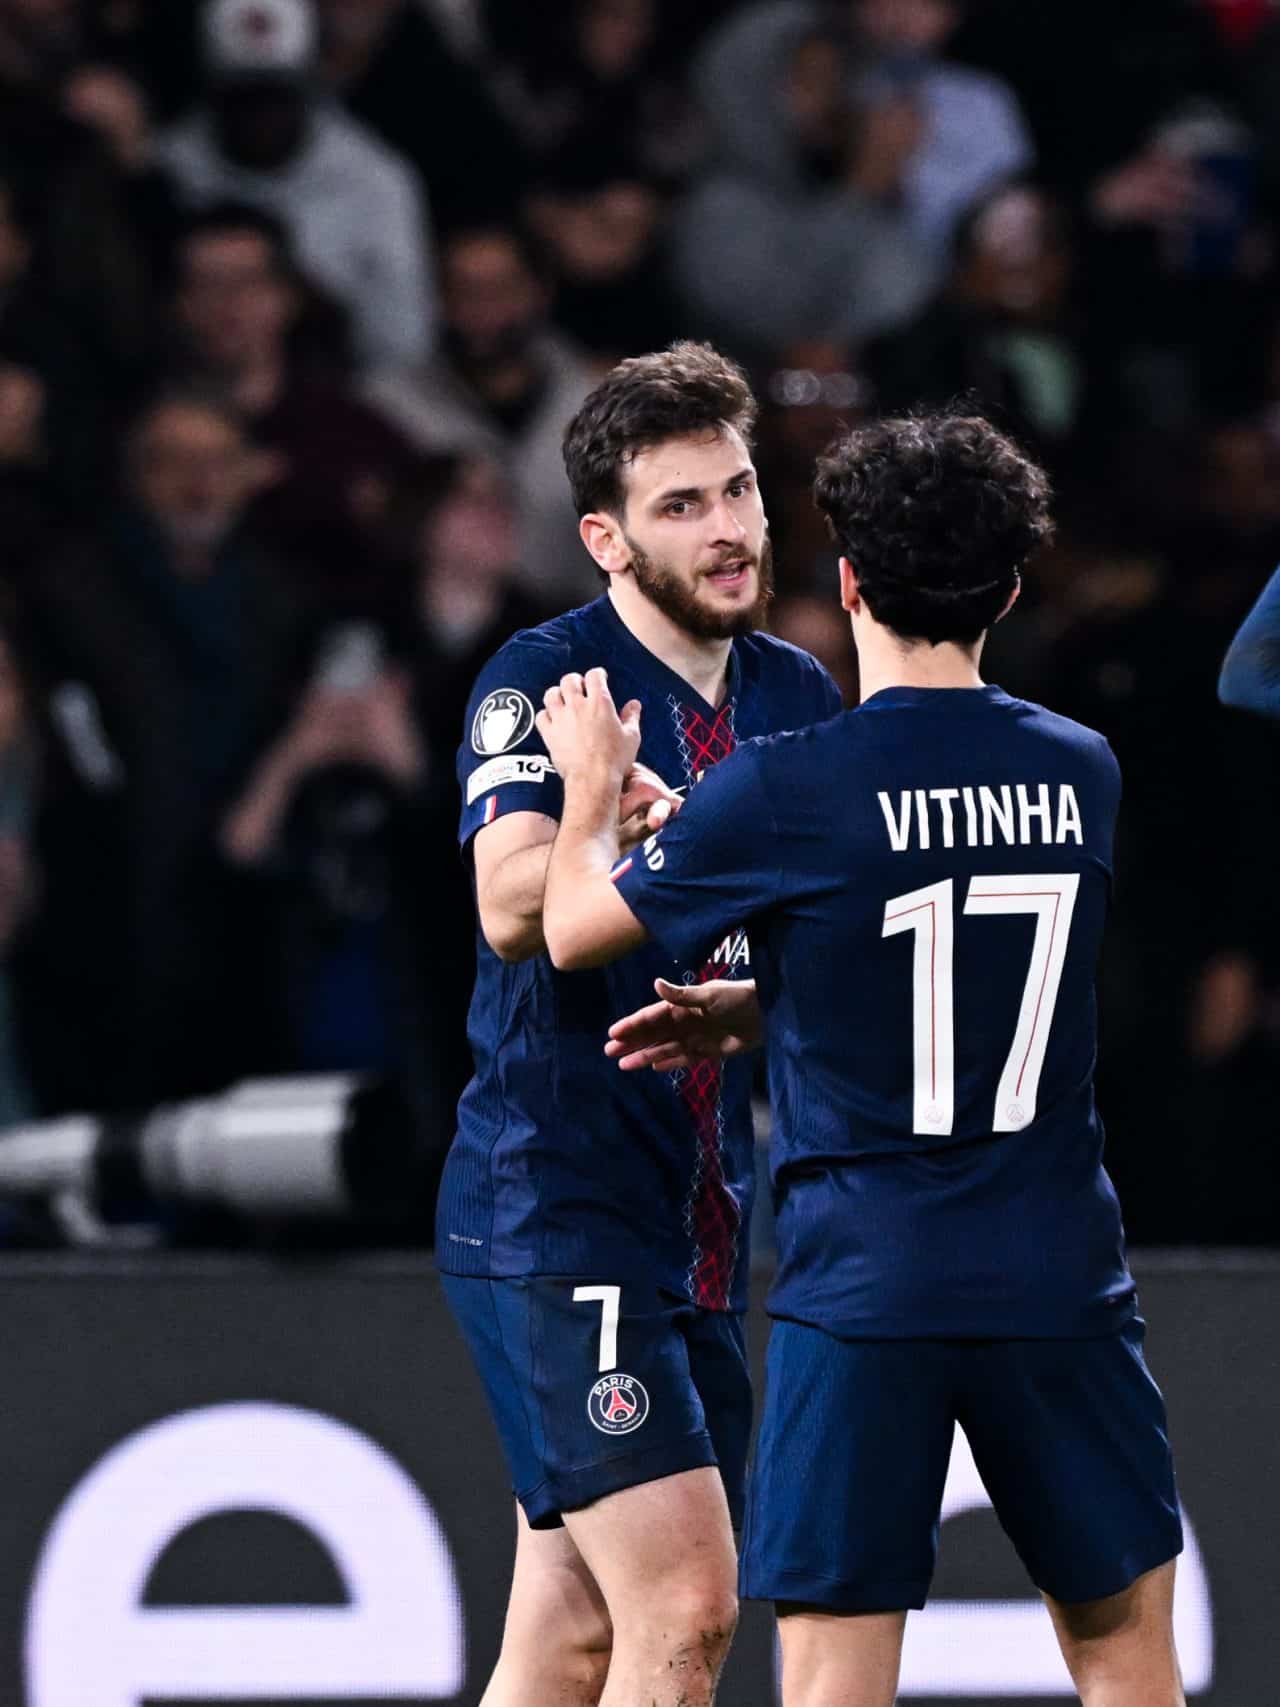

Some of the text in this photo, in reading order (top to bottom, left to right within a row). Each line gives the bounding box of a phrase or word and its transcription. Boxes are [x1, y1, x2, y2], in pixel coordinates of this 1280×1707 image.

[877, 783, 1084, 852] VITINHA
[881, 872, 1081, 1136] 17
[572, 1285, 621, 1373] 7
[594, 1377, 634, 1396] PARIS
